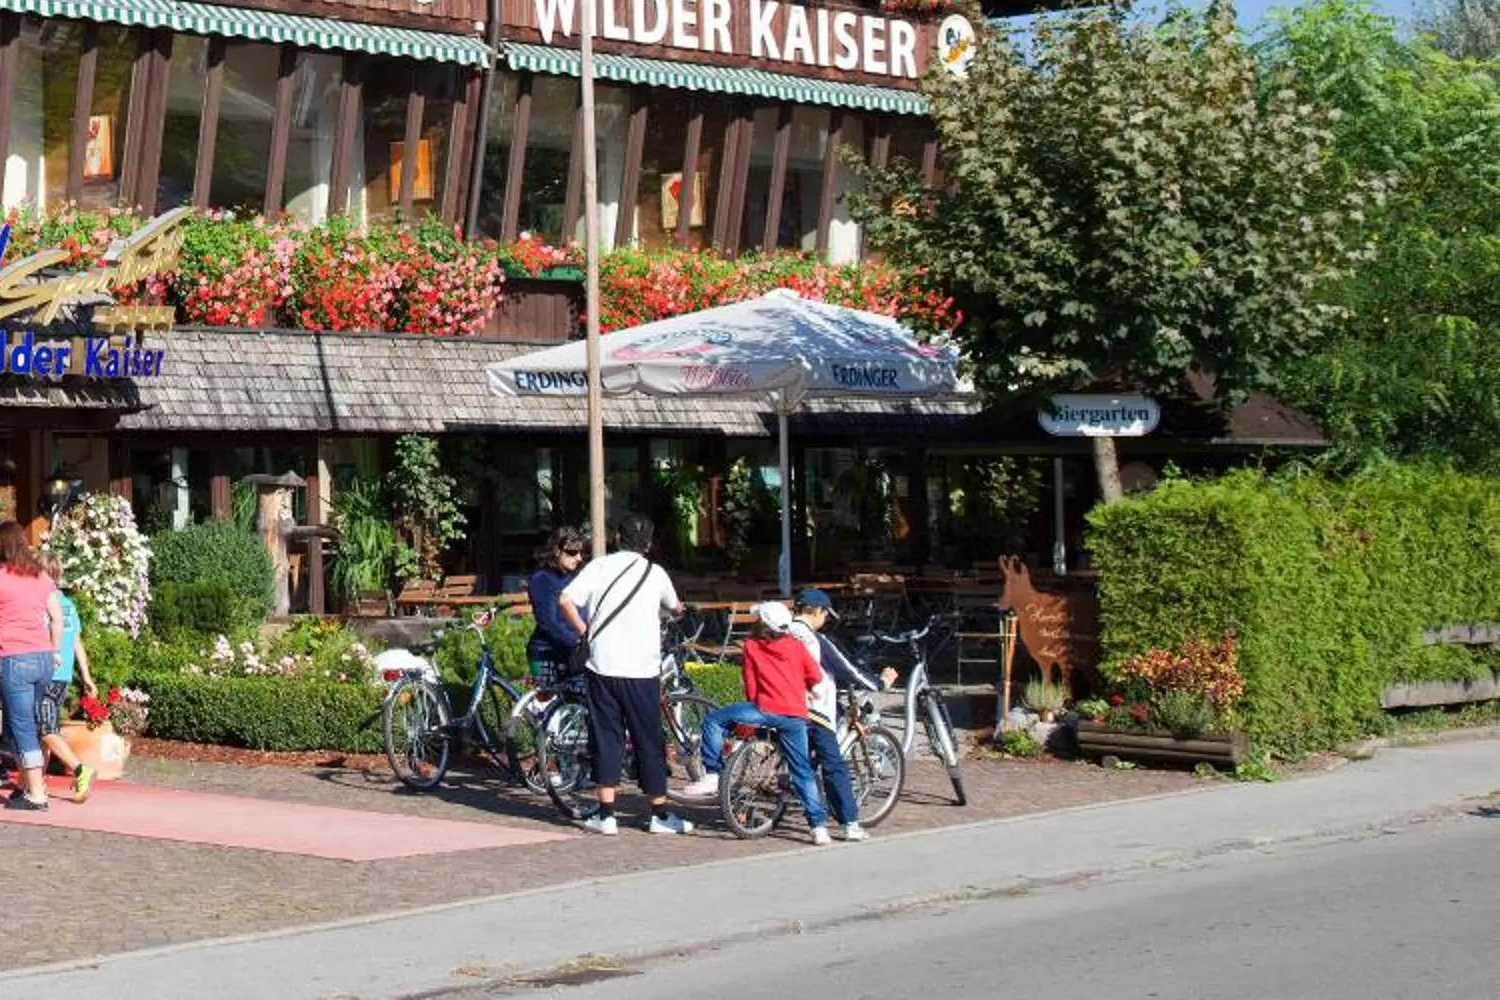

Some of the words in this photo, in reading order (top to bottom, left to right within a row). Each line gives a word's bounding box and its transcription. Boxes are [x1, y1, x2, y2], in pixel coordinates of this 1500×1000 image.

[85, 336, 164, 377] Kaiser
[514, 369, 606, 393] ERDING
[1051, 404, 1149, 425] Biergarten
